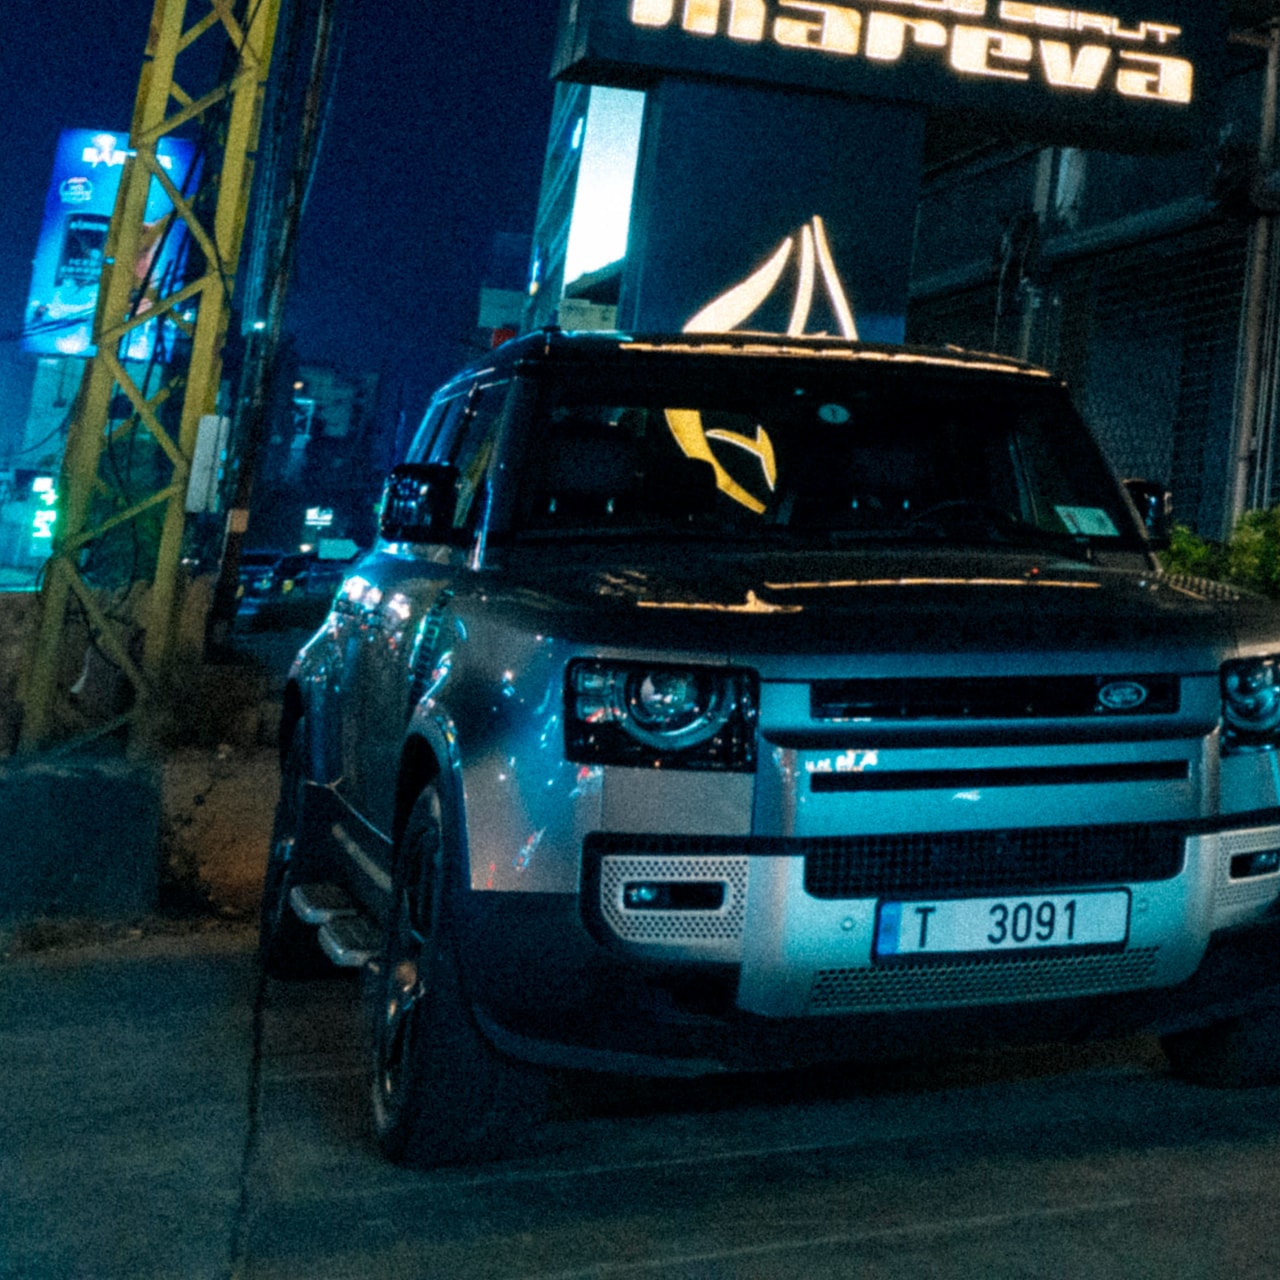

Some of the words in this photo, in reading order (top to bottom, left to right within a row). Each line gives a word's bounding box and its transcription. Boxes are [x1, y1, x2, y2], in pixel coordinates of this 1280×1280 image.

[999, 0, 1181, 44] BEIRUT
[914, 906, 936, 948] T
[987, 899, 1076, 945] 3091
